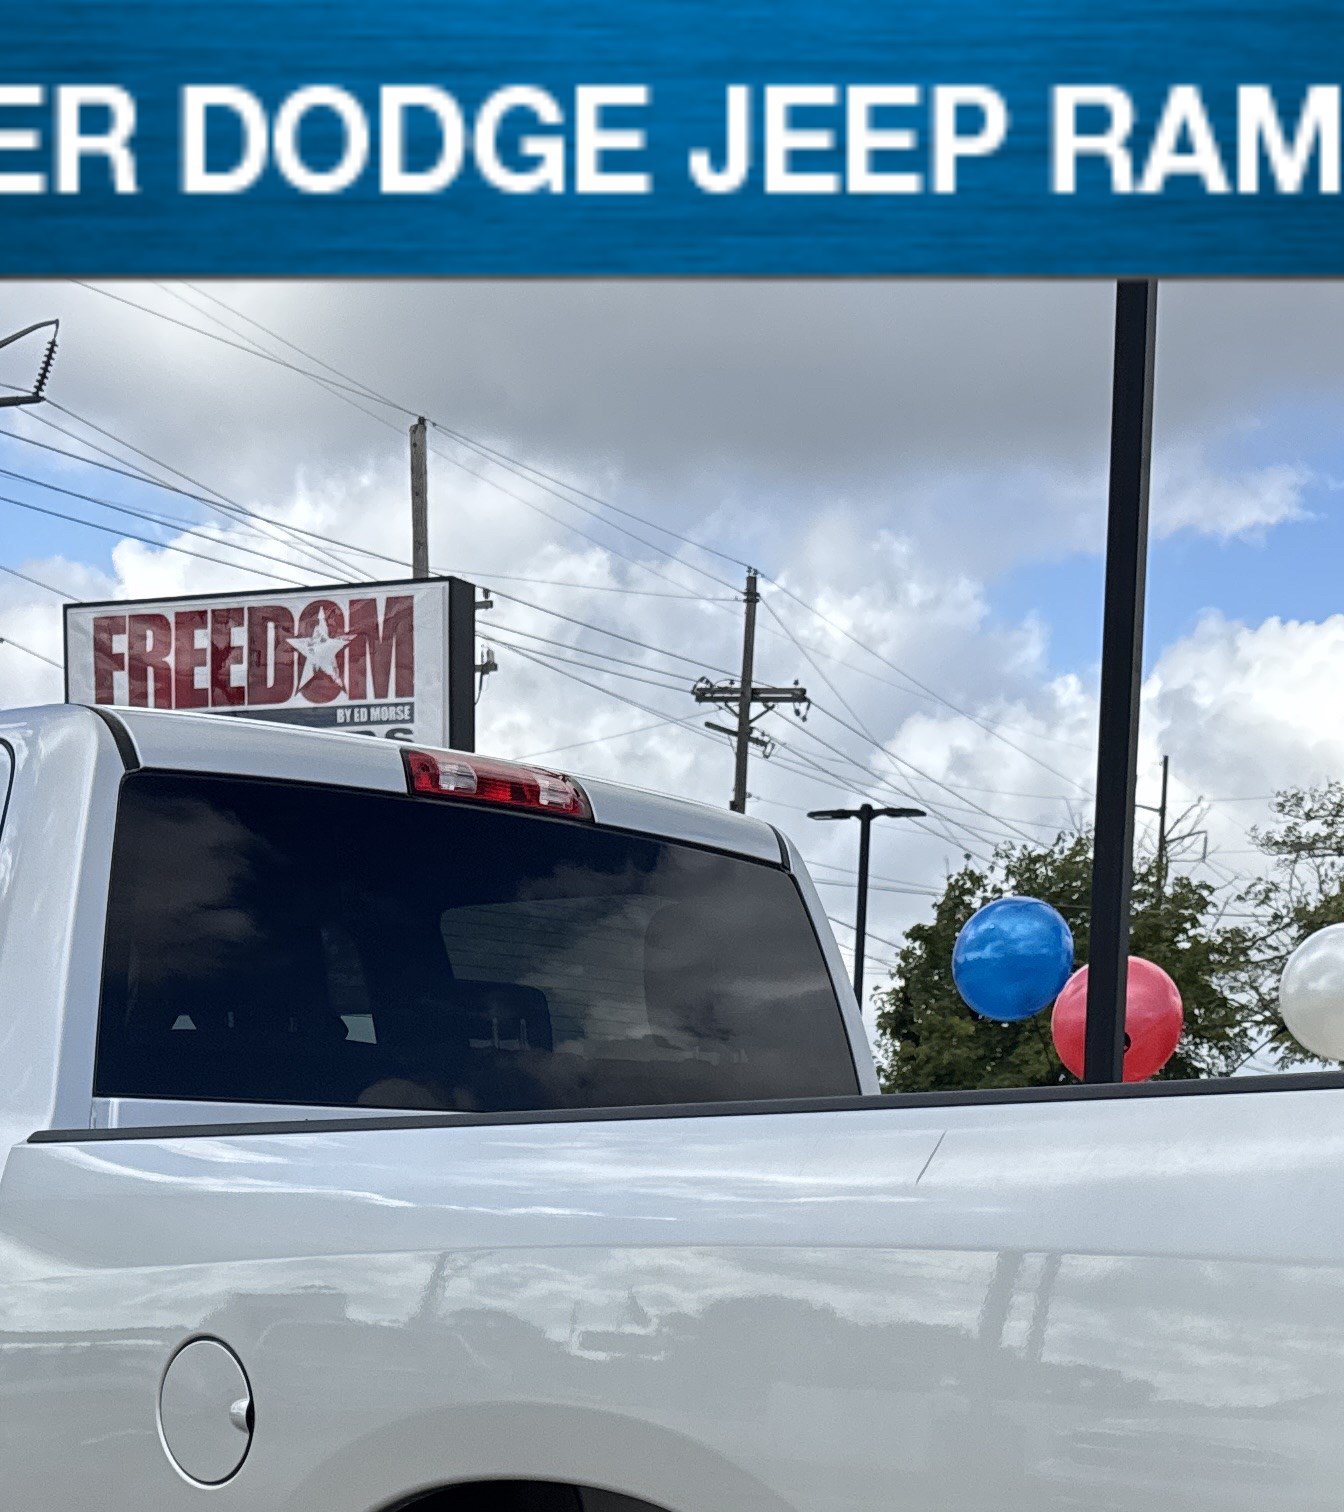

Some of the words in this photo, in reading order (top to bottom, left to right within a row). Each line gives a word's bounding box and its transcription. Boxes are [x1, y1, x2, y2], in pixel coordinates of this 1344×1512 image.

[92, 596, 415, 710] FREEDOM
[336, 708, 351, 723] BY
[353, 707, 367, 722] ED
[370, 704, 411, 721] MORSE
